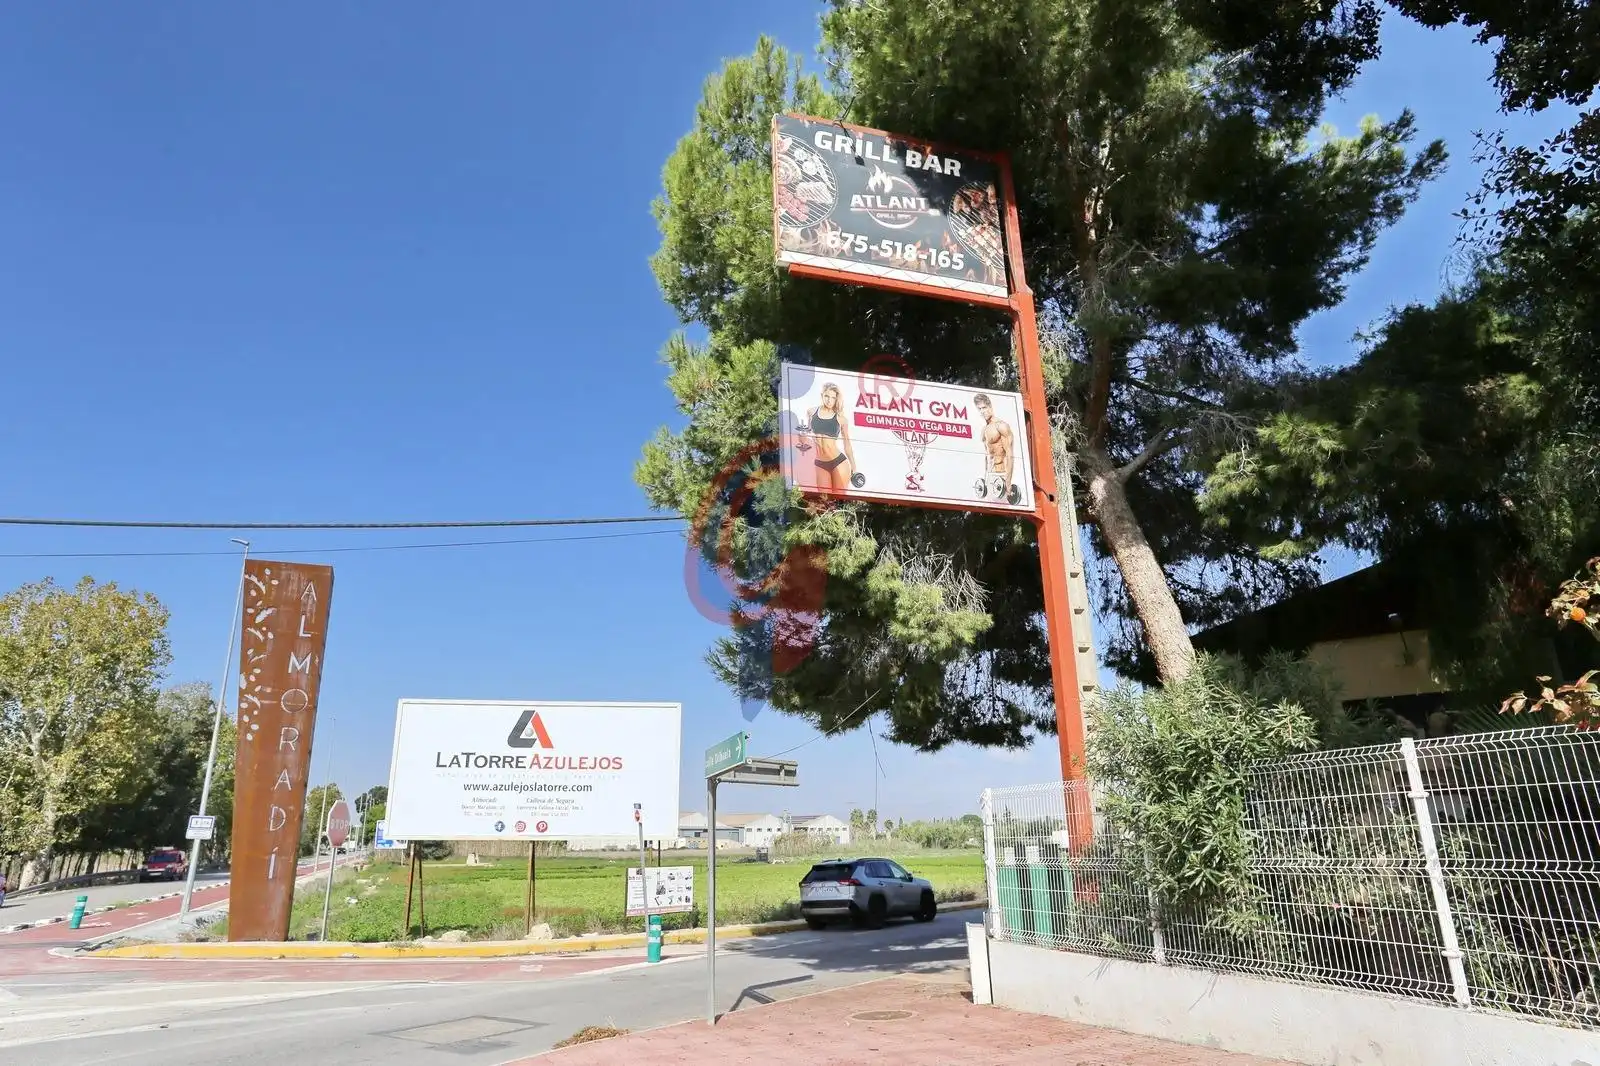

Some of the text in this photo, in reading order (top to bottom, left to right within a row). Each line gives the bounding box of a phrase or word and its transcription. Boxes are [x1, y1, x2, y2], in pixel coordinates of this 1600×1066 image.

[814, 131, 962, 177] GRILL BAR
[851, 194, 929, 210] ATLANT
[826, 231, 964, 270] 675-518-165
[856, 392, 968, 420] ATLANT GYM
[866, 415, 968, 435] GIMNASIO VEGA BAJA
[268, 581, 317, 879] ALMORADÍ
[529, 754, 623, 770] AZULEJOS
[463, 782, 593, 794] www.azulejoslatorre.com
[330, 818, 350, 830] STOP
